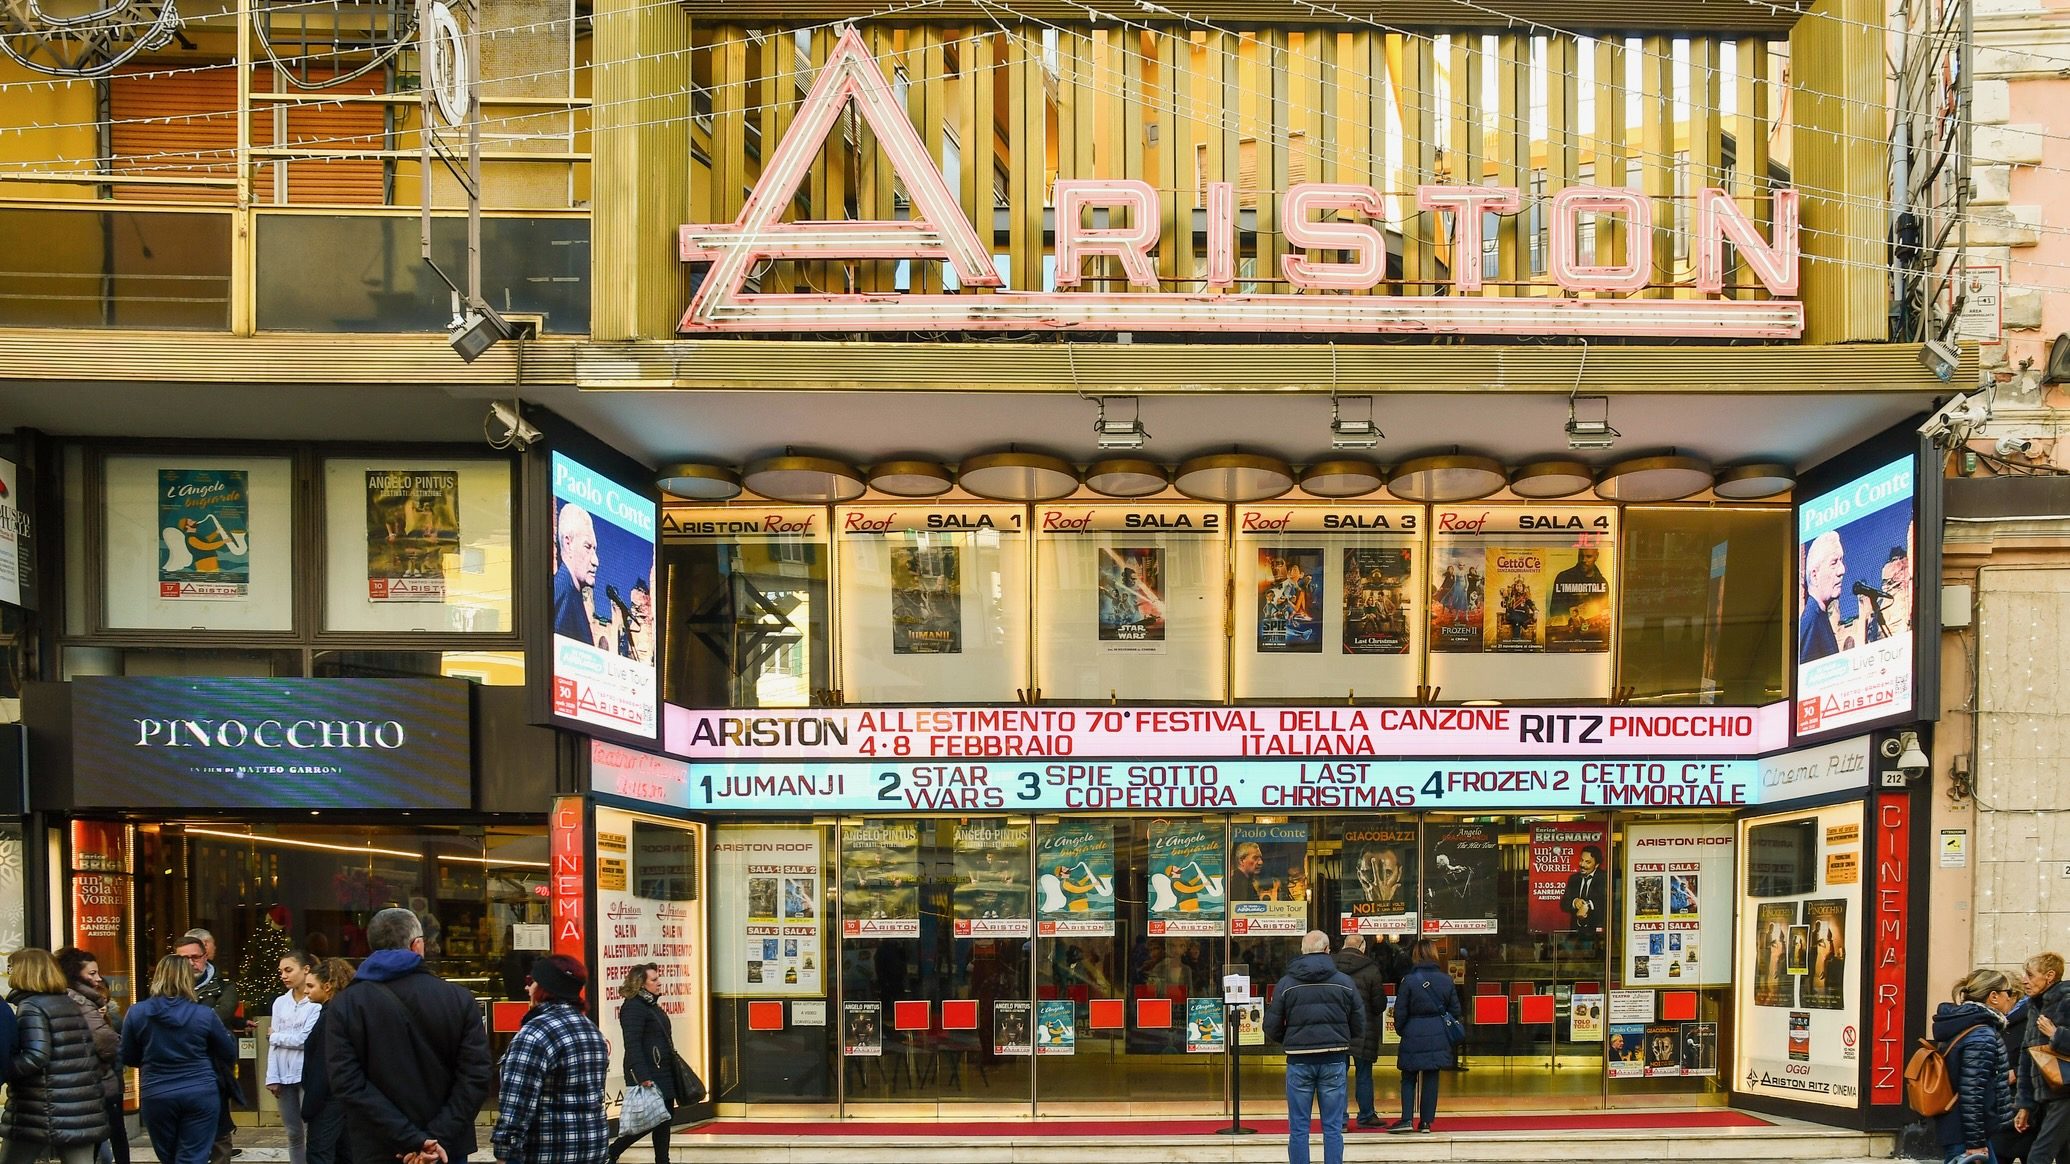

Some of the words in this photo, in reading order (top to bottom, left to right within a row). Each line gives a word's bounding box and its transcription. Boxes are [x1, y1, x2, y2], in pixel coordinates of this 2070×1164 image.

[678, 24, 1804, 337] ARISTON
[167, 480, 225, 498] L'Angelo
[368, 476, 412, 489] ANGELO
[415, 476, 454, 489] PINTUS
[555, 461, 601, 506] Paolo
[605, 490, 651, 531] Conte
[1804, 494, 1850, 532] Paolo
[1854, 468, 1910, 503] Conte
[662, 514, 758, 534] ARISTON
[764, 514, 816, 539] Roof
[844, 511, 899, 537] Roof
[927, 514, 994, 528] SALA
[1009, 514, 1021, 528] 1
[1043, 510, 1095, 536] Roof
[1125, 514, 1193, 528] SALA
[1203, 514, 1219, 528] 2
[1242, 510, 1294, 536] Roof
[1323, 514, 1390, 529] SALA
[1401, 514, 1416, 529] 3
[1439, 511, 1487, 536] Roof
[1519, 515, 1585, 529] SALA
[1593, 515, 1609, 529] 4
[1497, 556, 1525, 569] Cetto
[180, 583, 237, 595] ARISTON
[1556, 583, 1606, 593] L'IMMORTALE
[1117, 624, 1146, 632] STAR
[1441, 627, 1471, 635] FROZEN
[1117, 632, 1146, 640] WARS
[1354, 637, 1367, 645] Last
[1368, 637, 1398, 645] Christmas
[1852, 653, 1876, 671] Live
[1878, 645, 1903, 663] Tour
[607, 660, 628, 681] Live
[629, 664, 650, 686] Tour
[560, 686, 572, 699] 30
[579, 687, 642, 723] ARISTON
[1804, 705, 1815, 718] 30
[1821, 690, 1894, 719] ARISTON
[858, 711, 1076, 733] ALLESTIMENTO
[1136, 710, 1265, 732] FESTIVAL
[1280, 709, 1369, 732] DELLA
[1380, 709, 1509, 732] CANZONE
[1610, 715, 1752, 737] PINOCCHIO
[134, 718, 405, 749] PINOCCHIO
[691, 717, 848, 748] ARISTON
[1519, 714, 1604, 744] RITZ
[930, 735, 1073, 757] FEBBRAIO
[1242, 734, 1376, 755] ITALIANA
[238, 766, 284, 774] MATTEO
[911, 766, 988, 787] STAR
[1045, 765, 1112, 785] SPIE
[1127, 766, 1218, 785] SOTTO
[1300, 764, 1370, 784] LAST
[1581, 763, 1665, 783] CETTO
[1763, 763, 1819, 788] Cinema
[1017, 772, 1040, 800] 3
[1420, 770, 1445, 799] 4
[1447, 770, 1548, 793] FROZEN
[1552, 770, 1569, 791] 2
[1886, 774, 1902, 784] 212
[700, 774, 713, 804] 1
[716, 774, 844, 798] JUMANJI
[878, 772, 903, 801] 2
[904, 787, 1004, 809] WARS
[1065, 786, 1237, 808] COPERTURA
[1262, 785, 1415, 807] CHRISTMAS
[1580, 784, 1747, 805] L'IMMORTALE
[843, 830, 880, 841] ANGELO
[883, 830, 916, 841] PINTUS
[955, 830, 992, 841] ANGELO
[994, 830, 1028, 841] PINTUS
[1234, 827, 1266, 838] Paolo
[1270, 827, 1306, 838] Conte
[1345, 831, 1415, 841] GIACOBAZZI
[1536, 832, 1601, 842] BRIGNANO
[1044, 832, 1094, 849] L'Angelo
[1156, 832, 1206, 849] L'Angelo
[1636, 838, 1695, 847] ARISTON
[1697, 837, 1733, 846] ROOF
[714, 844, 773, 852] ARISTON
[776, 844, 813, 852] ROOF
[1536, 853, 1558, 863] sola
[558, 808, 580, 941] CINEMA
[750, 866, 773, 874] SALA
[784, 866, 805, 874] SALA
[806, 866, 816, 874] 2
[82, 882, 111, 894] sola
[1880, 805, 1902, 968] CINEMA
[1269, 904, 1285, 912] Live
[1287, 904, 1302, 912] Tour
[1353, 902, 1375, 913] NOI
[1762, 905, 1794, 917] PINOCCHIO
[1808, 903, 1843, 915] PINOCCHIO
[861, 920, 917, 932] ARISTON
[972, 920, 1028, 932] ARISTON
[1056, 921, 1104, 931] ARISTON
[1167, 921, 1214, 931] ARISTON
[1248, 919, 1296, 930] ARISTON
[1358, 918, 1407, 929] ARISTON
[1440, 920, 1487, 929] ARISTON
[1634, 923, 1656, 931] SALA
[1669, 922, 1691, 930] SALA
[1692, 922, 1699, 930] 4
[614, 924, 629, 938] SALE
[630, 924, 637, 938] IN
[662, 924, 675, 938] SALE
[677, 924, 683, 938] IN
[748, 927, 770, 935] SALA
[772, 927, 779, 935] 3
[603, 944, 648, 958] ALLESTIMENTO
[652, 944, 692, 957] ALLESTIMENTO
[606, 966, 618, 980] PER
[666, 963, 690, 977] FESTIVAL
[1875, 984, 1898, 1089] RITZ
[1786, 1064, 1811, 1075] OGGI
[1761, 1071, 1806, 1089] ARISTON
[1808, 1081, 1830, 1093] RITZ
[1832, 1083, 1857, 1097] CINEMA
